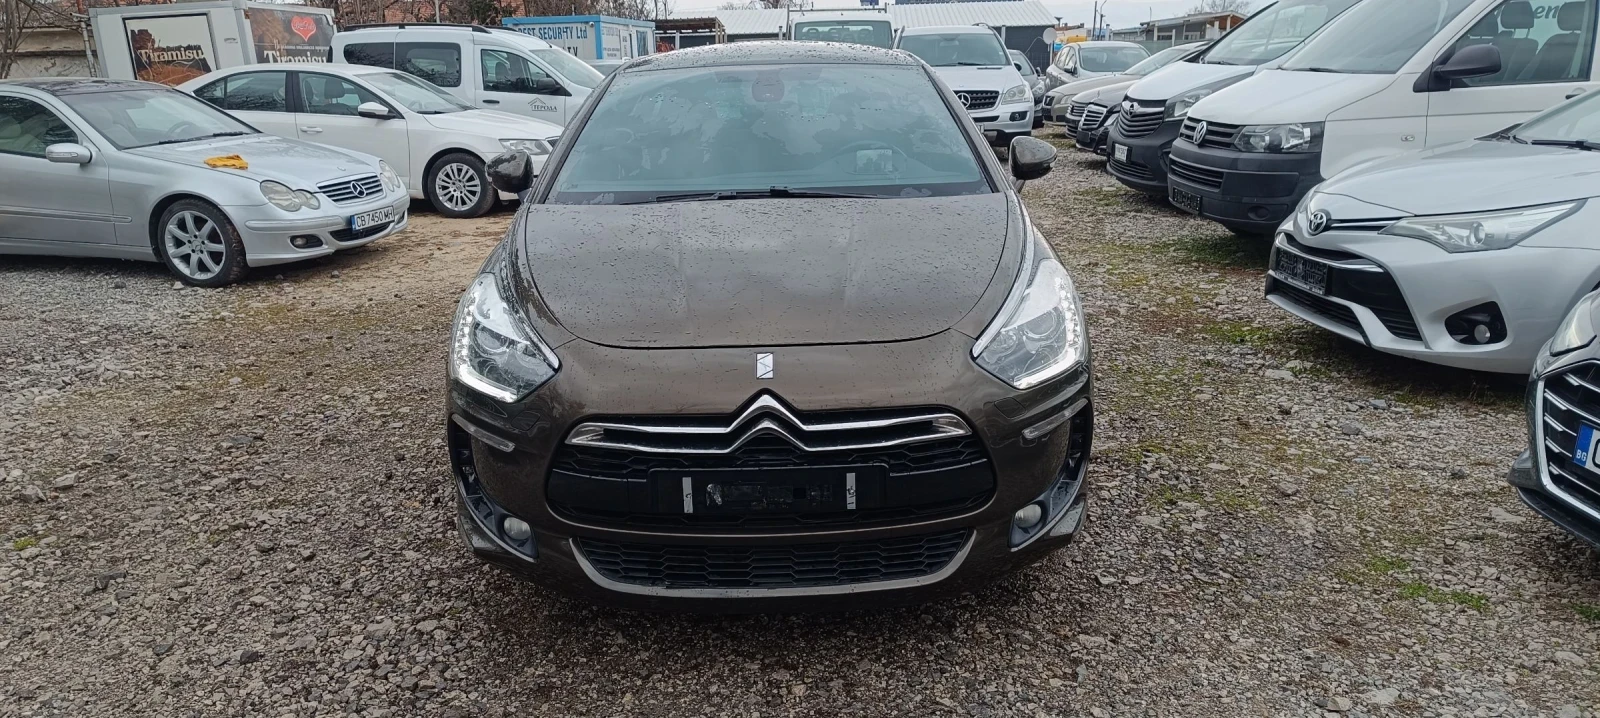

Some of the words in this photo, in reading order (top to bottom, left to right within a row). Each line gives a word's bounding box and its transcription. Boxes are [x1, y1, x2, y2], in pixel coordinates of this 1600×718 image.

[576, 26, 588, 39] Ltd
[138, 47, 205, 62] Tiramisu
[1576, 449, 1587, 461] BG
